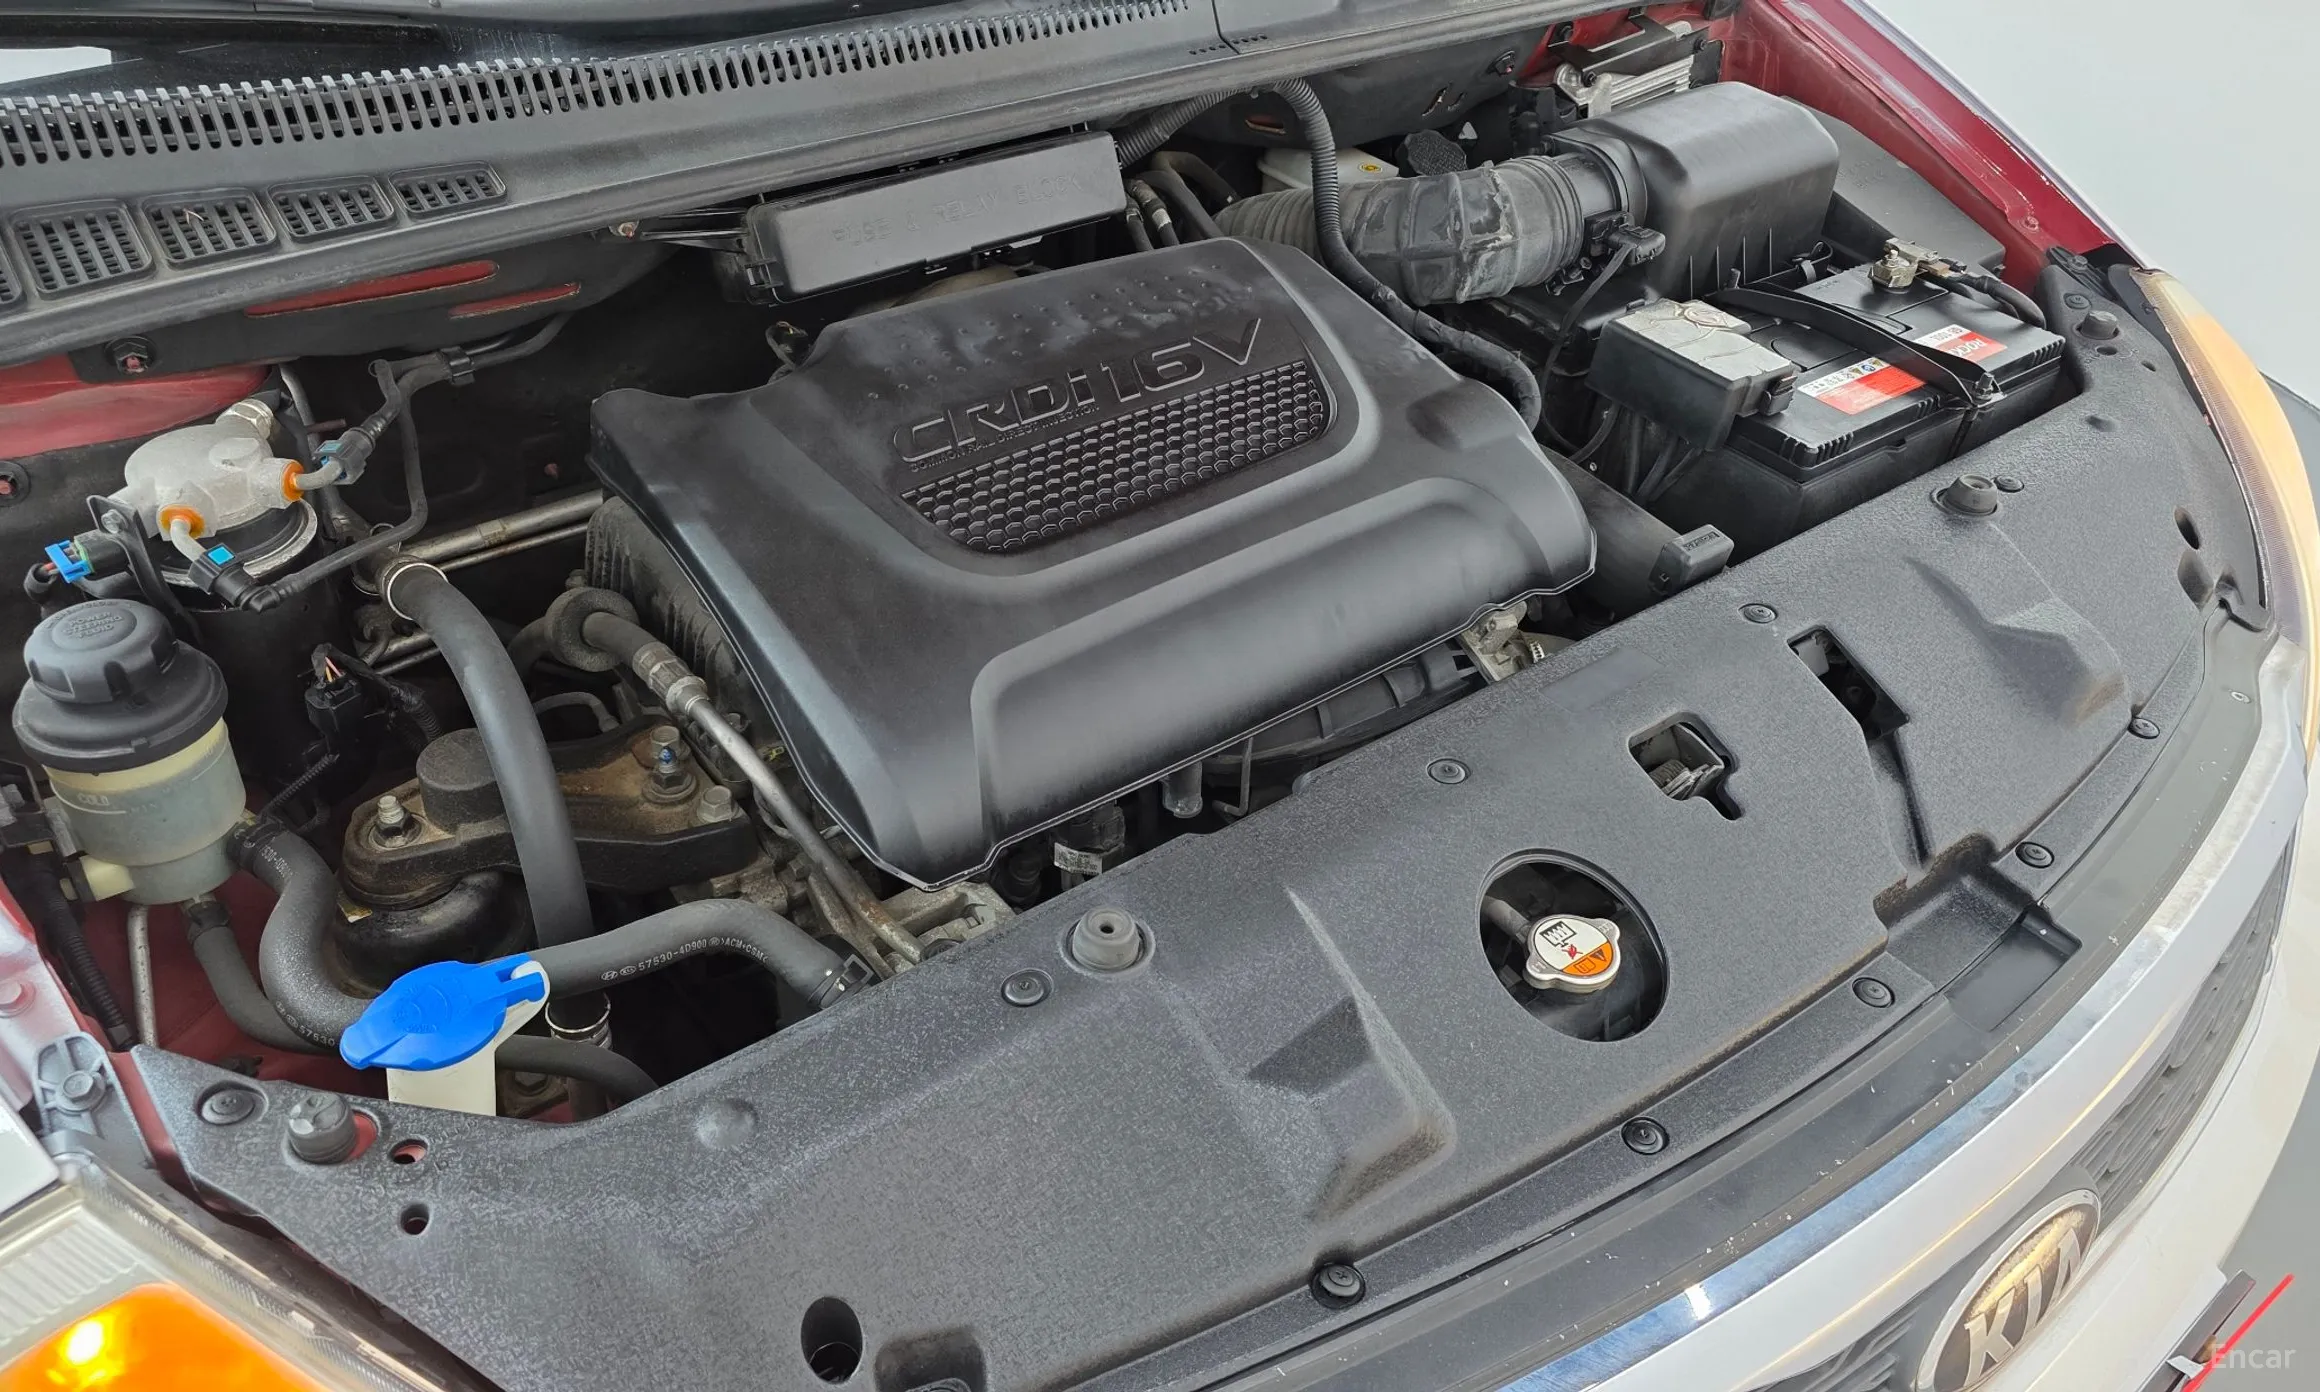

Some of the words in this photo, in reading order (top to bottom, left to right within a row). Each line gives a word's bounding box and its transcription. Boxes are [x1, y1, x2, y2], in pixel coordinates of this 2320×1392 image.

[932, 190, 1001, 223] RELAY
[1015, 173, 1084, 206] BLOCK
[894, 368, 1096, 463] CRDi
[1101, 317, 1261, 402] 16V
[910, 449, 966, 472] COMMON
[967, 438, 996, 453] RAIL
[997, 424, 1039, 443] DIRECT
[1041, 404, 1100, 428] INJECTION
[63, 616, 123, 636] STEERING
[70, 611, 112, 627] POWER
[76, 624, 115, 639] FLUID
[77, 792, 110, 806] COLD
[638, 938, 707, 972] 57530-4D900
[1963, 1228, 2082, 1388] KIA
